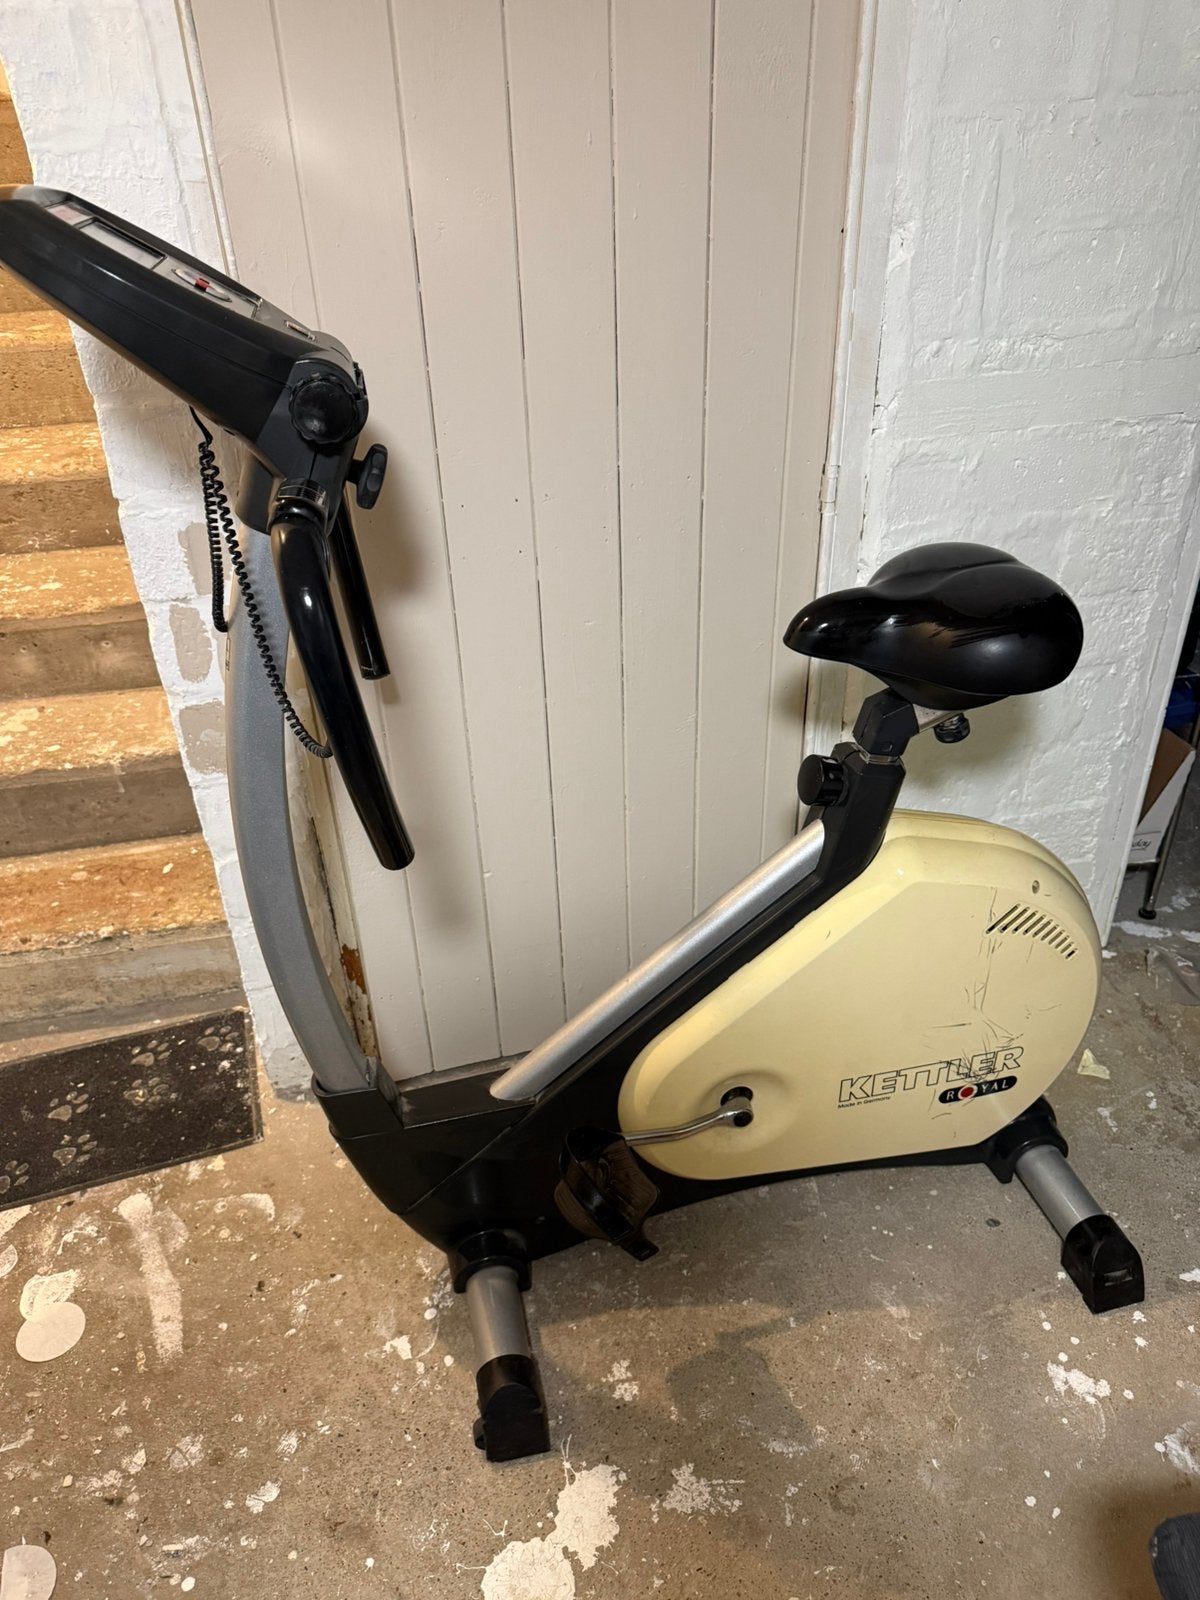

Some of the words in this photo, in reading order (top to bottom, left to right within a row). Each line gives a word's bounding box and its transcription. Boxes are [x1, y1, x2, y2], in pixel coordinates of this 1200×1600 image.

[838, 1046, 1025, 1102] KETTLER
[863, 1096, 891, 1104] Germany
[946, 1079, 1009, 1101] ROYAL
